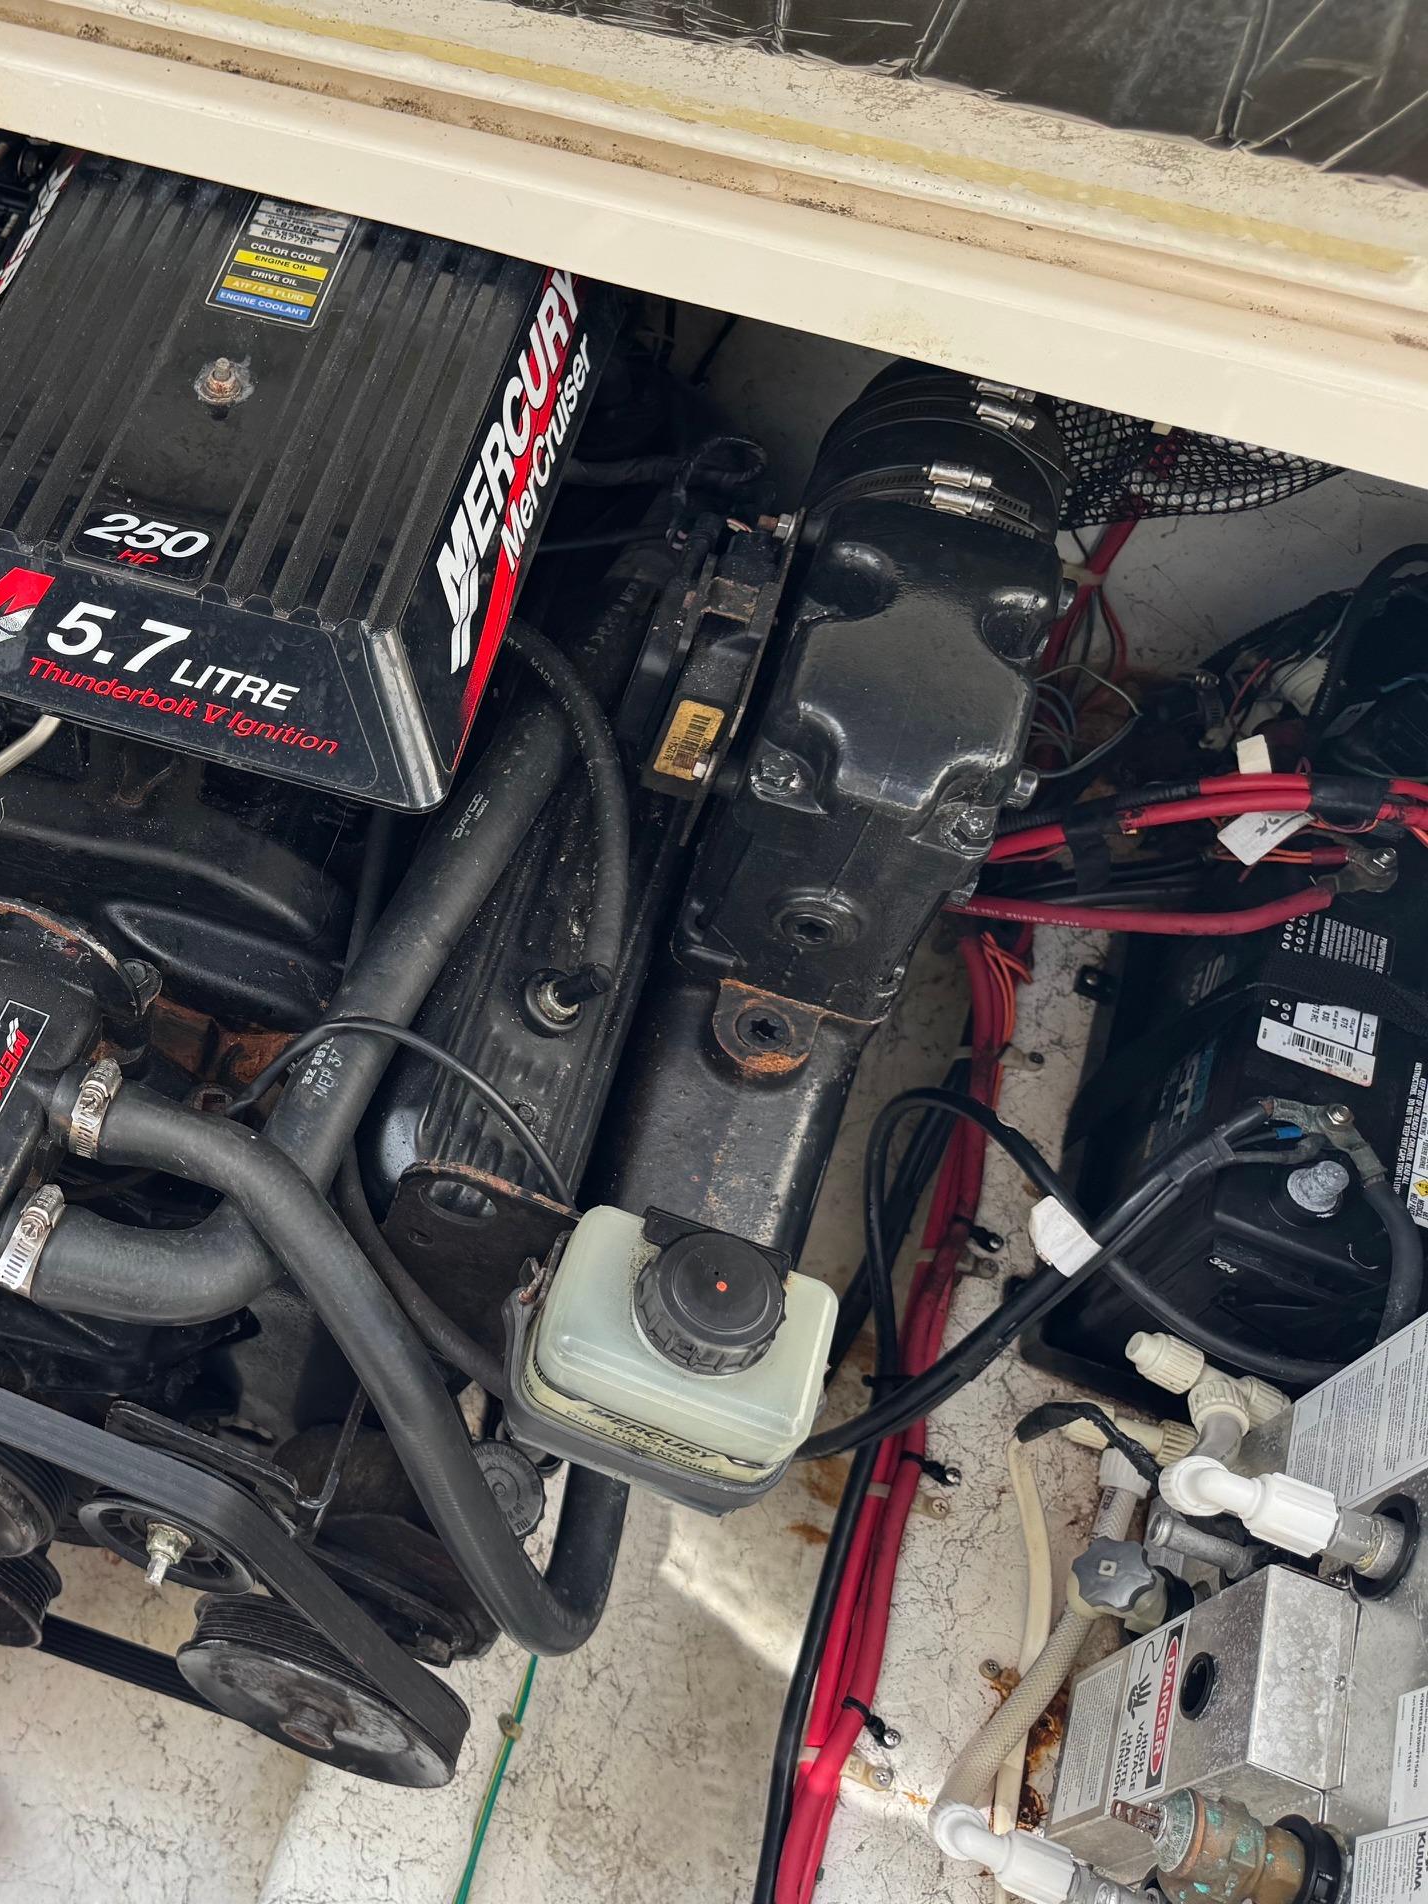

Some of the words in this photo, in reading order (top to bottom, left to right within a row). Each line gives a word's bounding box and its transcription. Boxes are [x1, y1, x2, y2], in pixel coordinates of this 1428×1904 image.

[250, 242, 289, 257] COLOR
[290, 251, 322, 264] CODE
[255, 254, 291, 268] ENGINE
[292, 262, 308, 272] OIL
[251, 270, 280, 283] DRIVE
[281, 277, 298, 287] OIL
[219, 291, 256, 306] ENGINE
[258, 298, 306, 317] COOLANT
[276, 290, 305, 303] FLUID
[436, 270, 580, 625] MERCURY
[500, 333, 591, 573] MerCruiser
[83, 513, 210, 560] 250
[117, 548, 159, 569] HP
[46, 601, 192, 673] 5.7
[170, 657, 301, 711] LITRE
[28, 656, 198, 719] Thunderbolt
[203, 701, 231, 725] V
[226, 710, 341, 756] Ignition
[1405, 1105, 1414, 1116] NOT
[1407, 1098, 1415, 1106] DO
[1411, 1115, 1420, 1131] REACH
[1395, 1162, 1404, 1176] TIGHT
[1397, 1148, 1406, 1162] CAPS
[1403, 1162, 1412, 1176] READ
[1402, 1175, 1410, 1185] ALL
[565, 1410, 607, 1433] Drive
[611, 1430, 653, 1451] Lube
[656, 1449, 722, 1475] Monitor
[588, 1408, 717, 1458] MERCURY
[1152, 1656, 1177, 1754] DANGER
[1113, 1729, 1128, 1797] TENSION
[1119, 1735, 1133, 1788] HAUTE
[1129, 1720, 1145, 1791] VOLTAGE
[1137, 1733, 1149, 1774] HIGH
[1414, 1831, 1426, 1891] KUUMA
